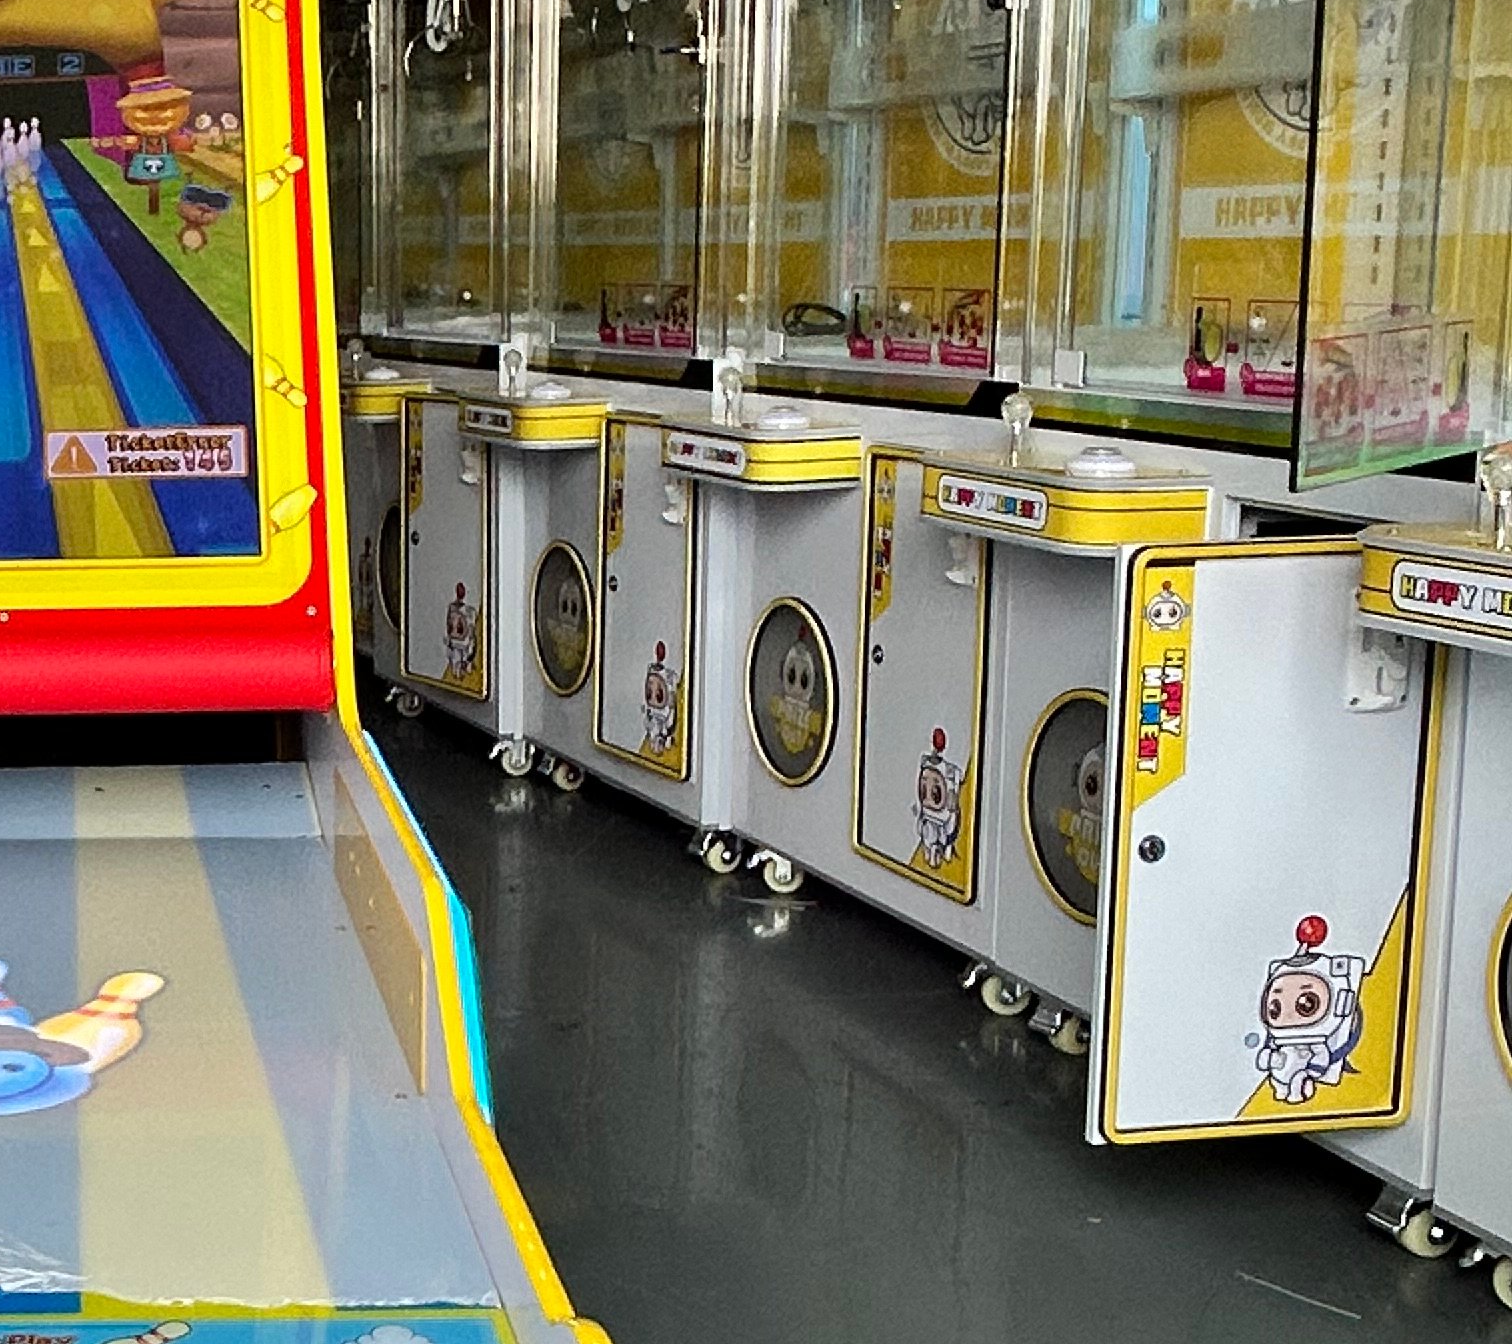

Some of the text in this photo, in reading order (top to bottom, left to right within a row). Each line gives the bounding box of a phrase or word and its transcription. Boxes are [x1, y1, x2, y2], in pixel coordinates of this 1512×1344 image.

[58, 54, 83, 75] 2
[1399, 573, 1478, 610] HAPPY
[1137, 664, 1163, 775] MOMENT
[1161, 648, 1186, 738] HAPPY
